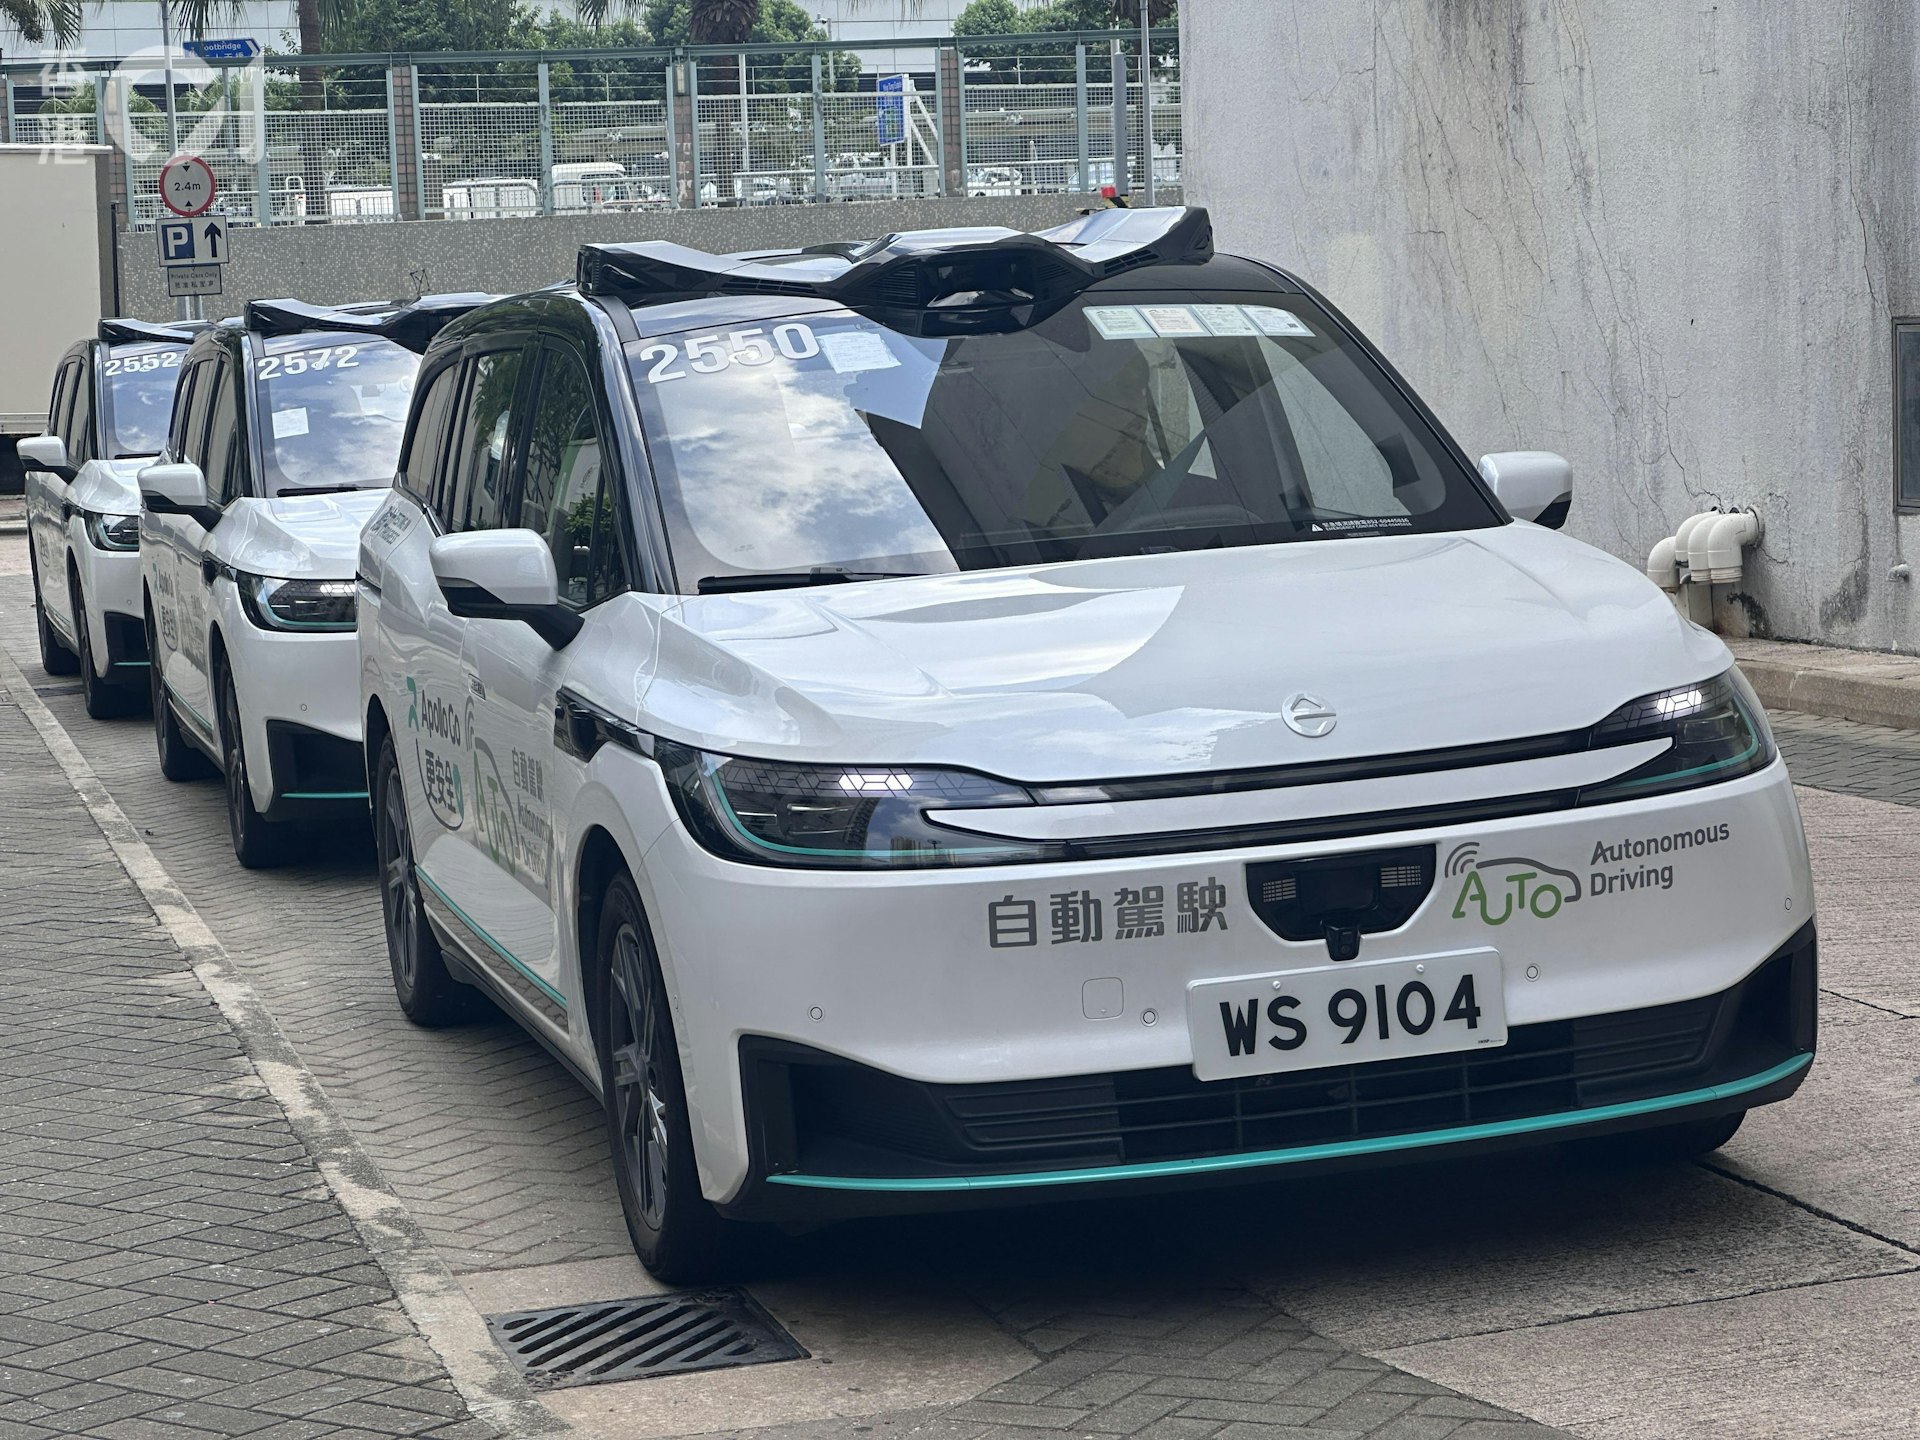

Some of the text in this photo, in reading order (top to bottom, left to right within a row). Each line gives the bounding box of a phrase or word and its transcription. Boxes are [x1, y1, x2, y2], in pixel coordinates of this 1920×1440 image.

[174, 182, 201, 192] 2.4m
[166, 226, 189, 257] P
[104, 351, 179, 377] 2552
[258, 346, 359, 380] 2572
[640, 323, 820, 384] 2550
[425, 749, 457, 814] 更安全
[1590, 823, 1730, 866] Autonomous
[1590, 864, 1674, 897] Driving
[988, 876, 1229, 949] 自動駕駛
[1219, 973, 1482, 1057] WS 9104
